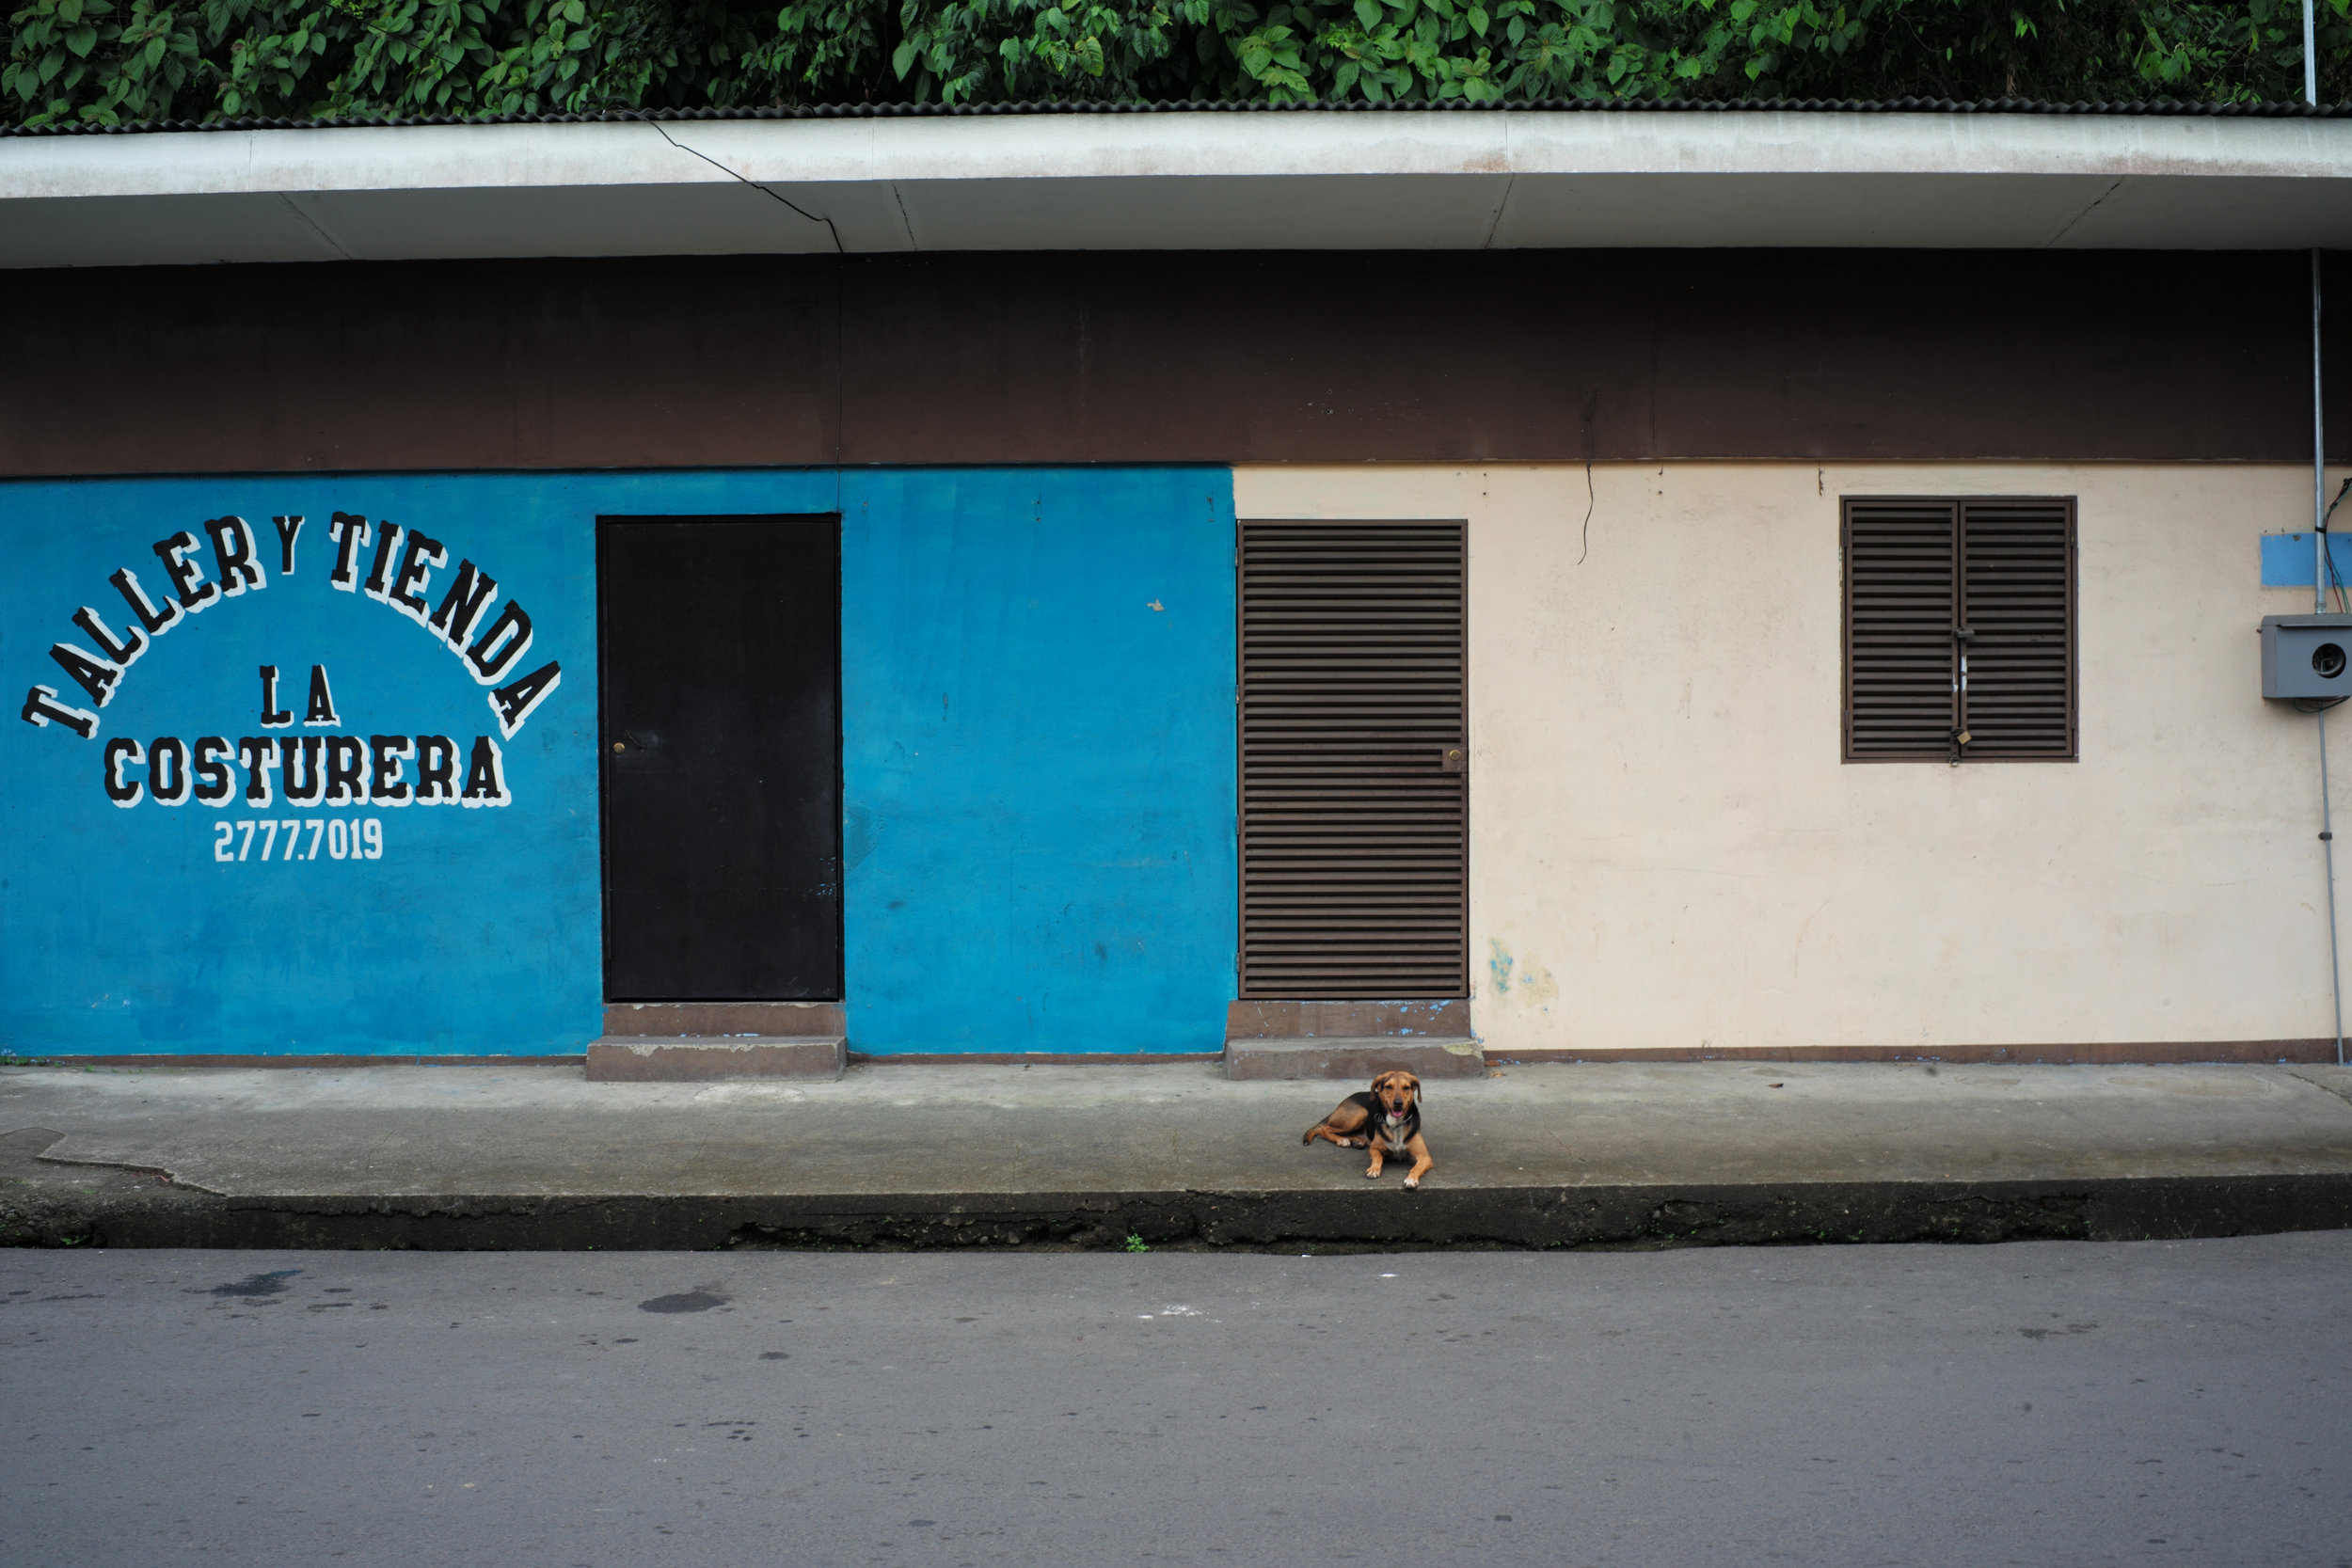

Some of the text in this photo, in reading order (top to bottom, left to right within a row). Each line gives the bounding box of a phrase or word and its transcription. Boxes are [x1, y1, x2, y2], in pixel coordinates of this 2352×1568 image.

[21, 511, 562, 741] TALLER Y TIENDA
[260, 664, 341, 728] LA
[103, 735, 512, 809] COSTURERA
[215, 818, 384, 863] 2777.7019
